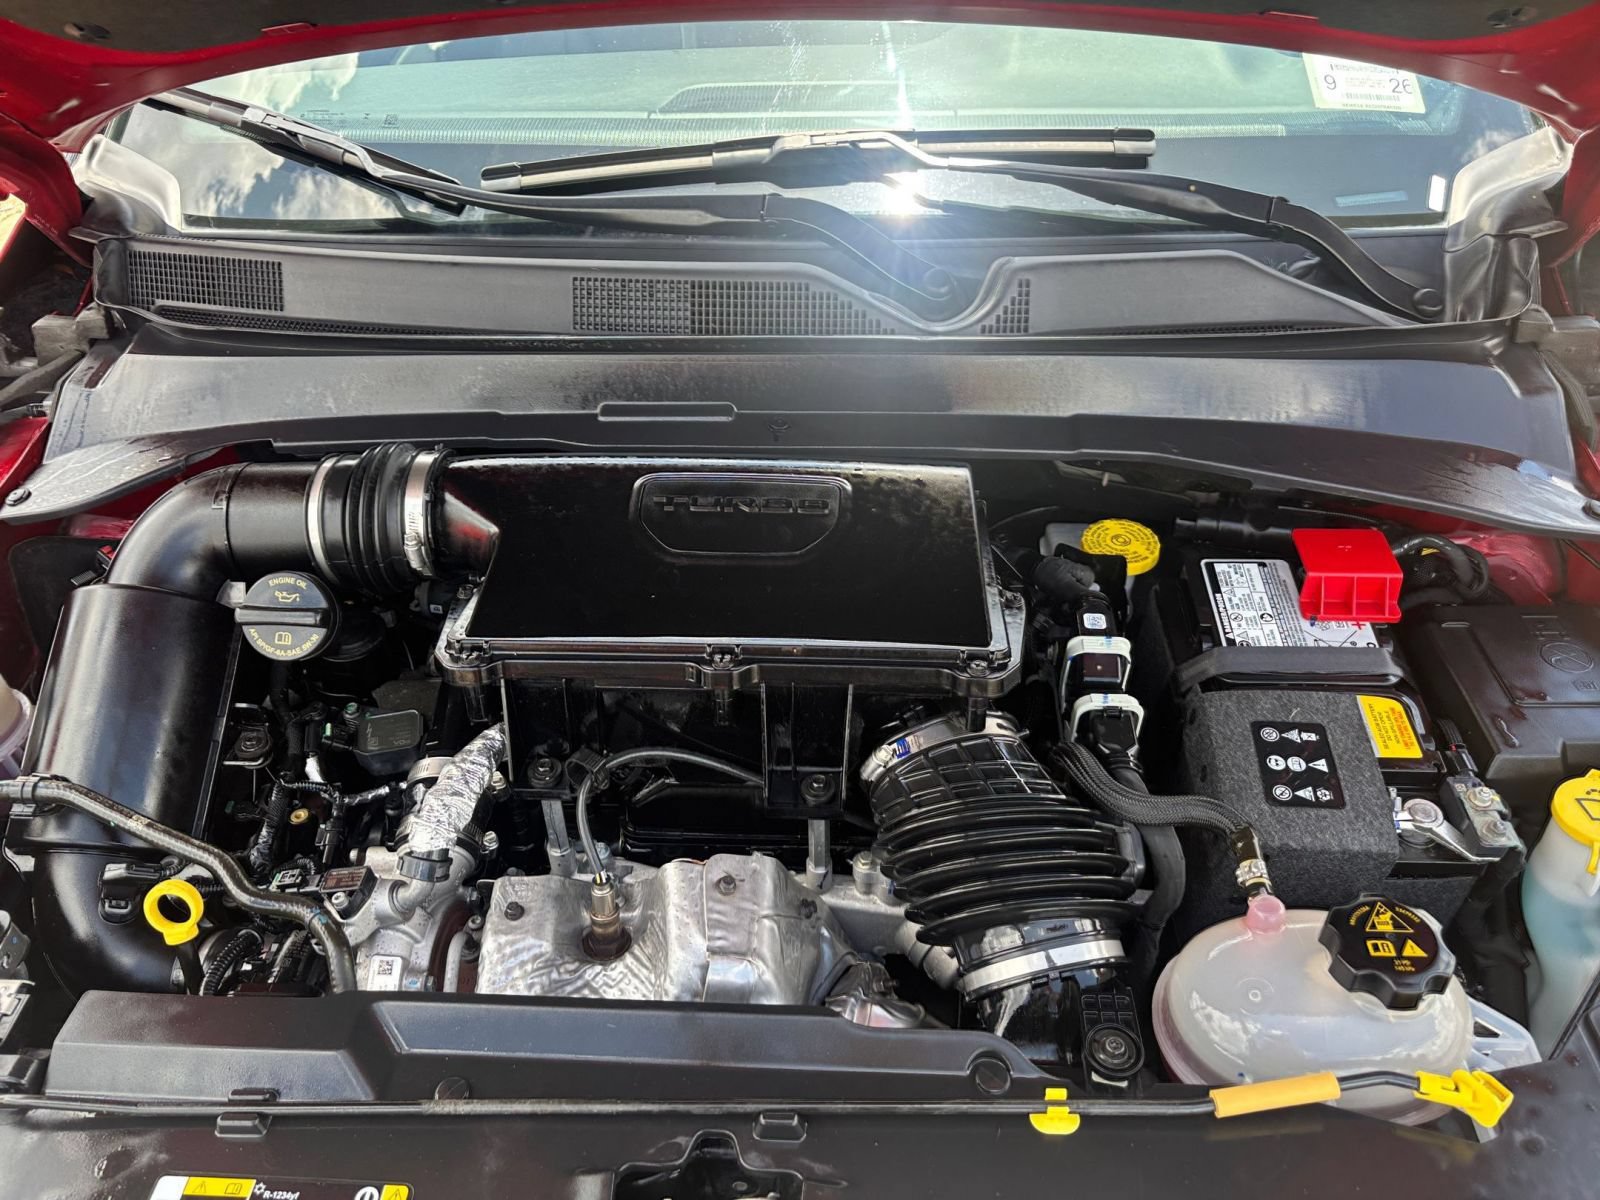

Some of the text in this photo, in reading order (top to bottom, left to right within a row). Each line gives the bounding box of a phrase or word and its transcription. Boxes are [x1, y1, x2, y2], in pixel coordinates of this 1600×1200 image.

[1323, 74, 1337, 91] 9
[653, 496, 830, 515] TURBO
[268, 576, 308, 590] ENGINE OIL
[248, 628, 259, 641] API
[263, 1190, 300, 1200] R-1234yf
